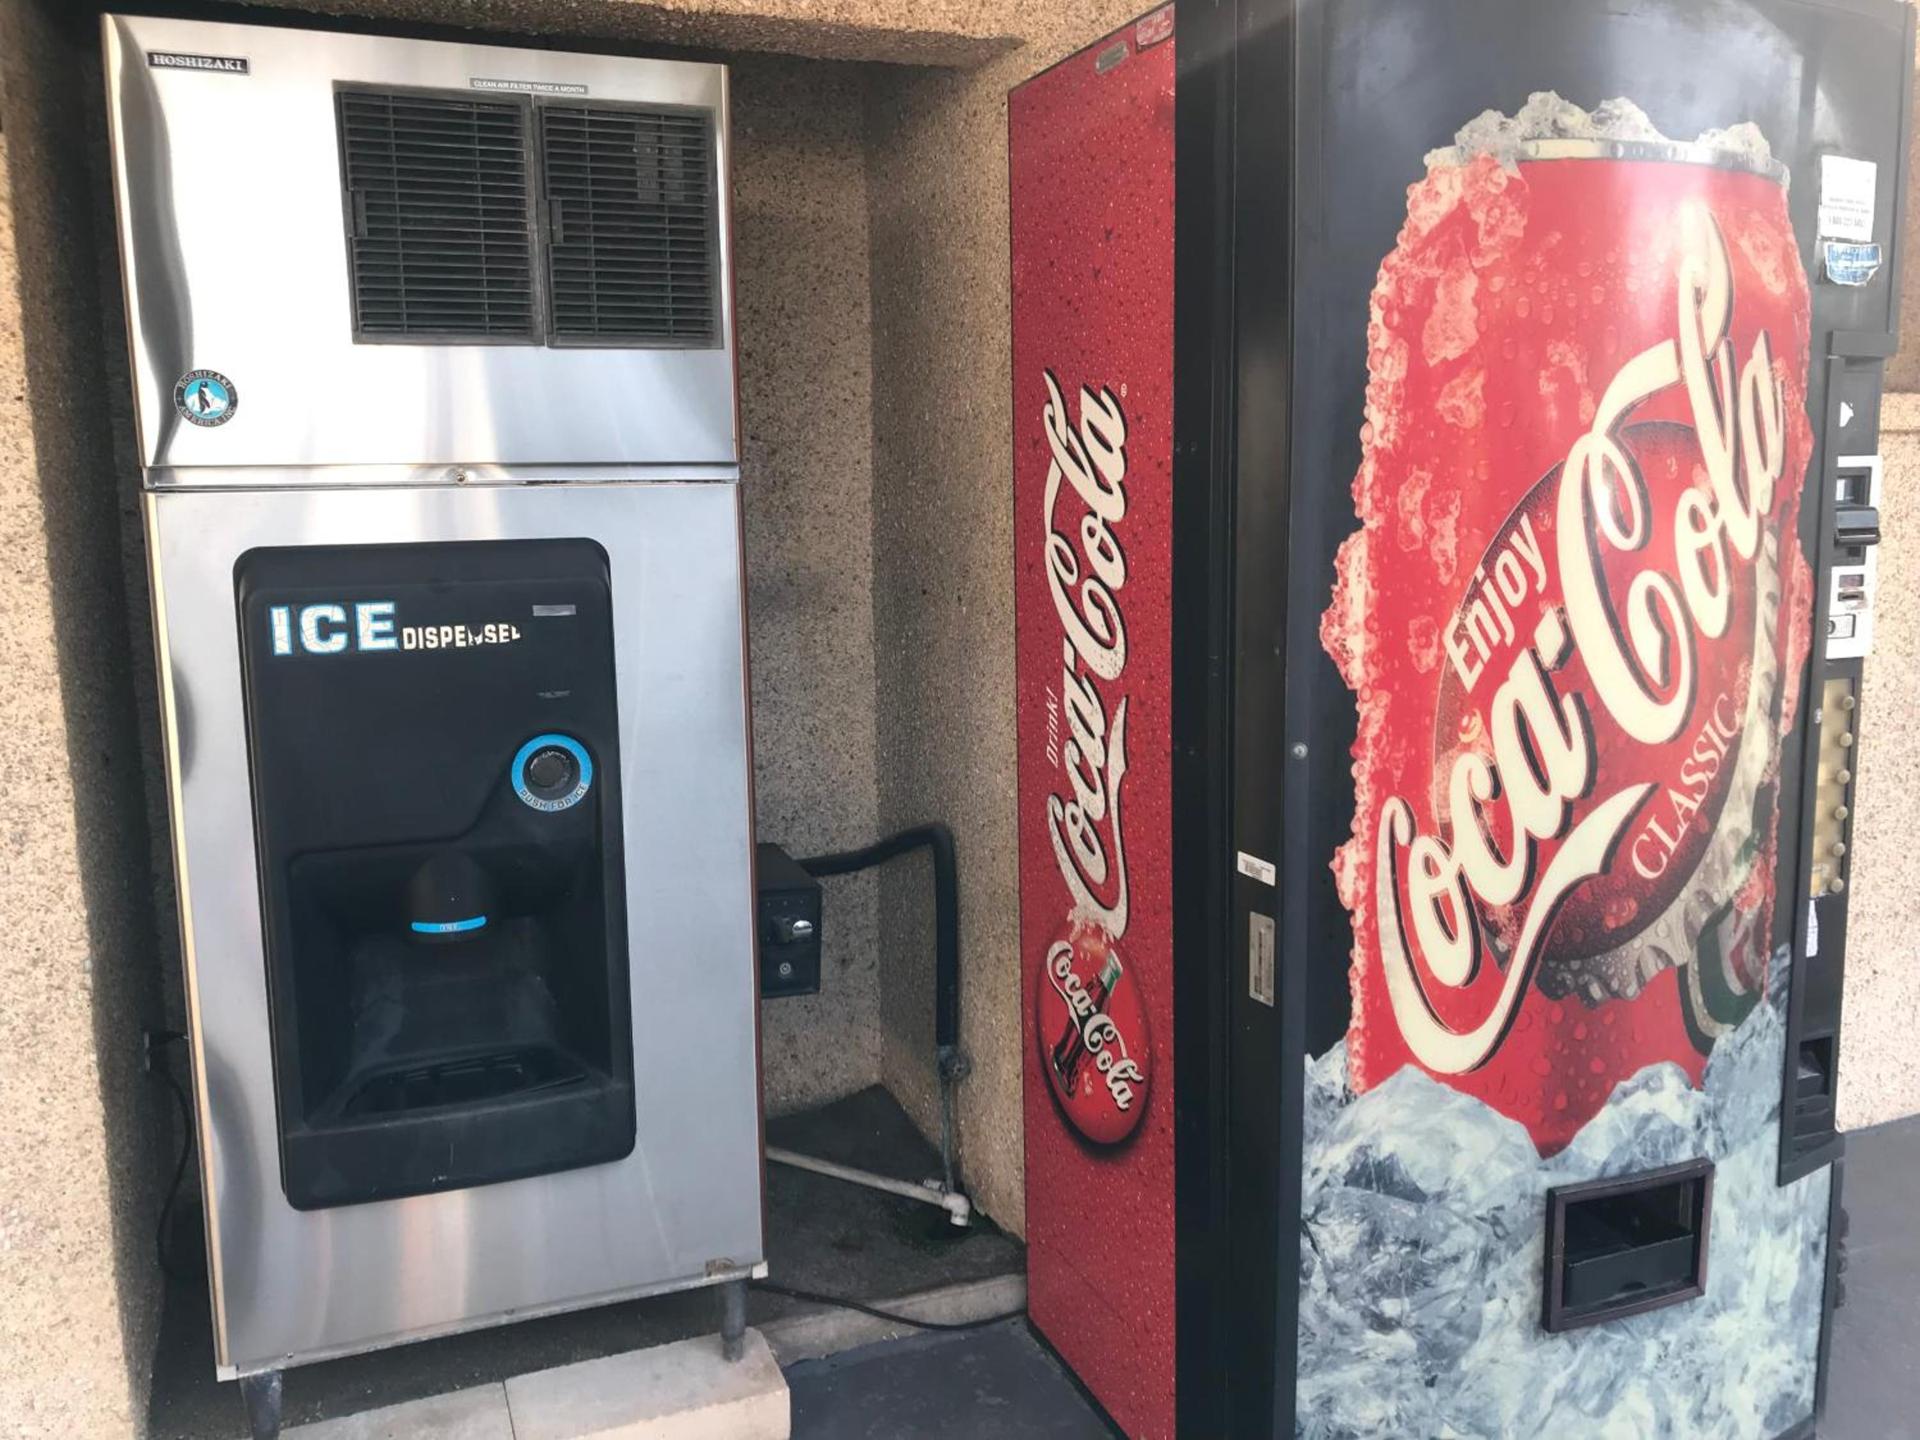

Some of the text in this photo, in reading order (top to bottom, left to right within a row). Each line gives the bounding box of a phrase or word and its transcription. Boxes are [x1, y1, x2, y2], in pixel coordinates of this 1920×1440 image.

[152, 54, 243, 71] HOSHIZAKI
[473, 80, 496, 89] CLEAN
[497, 81, 509, 90] AIR
[510, 82, 532, 91] FILTER
[533, 83, 553, 92] TWICE
[560, 86, 585, 94] MONTH
[179, 371, 232, 389] HOSHIZAKI
[269, 601, 399, 656] ICE
[1376, 204, 1786, 1076] Coca-Cola
[1442, 512, 1547, 694] Enjoy
[1044, 368, 1129, 940] Coca-Cola
[1046, 686, 1059, 769] Drink!
[520, 784, 588, 810] PUSH FOR ICE
[1632, 693, 1740, 879] CLASSIC
[1047, 940, 1144, 1111] Coca-Cola
